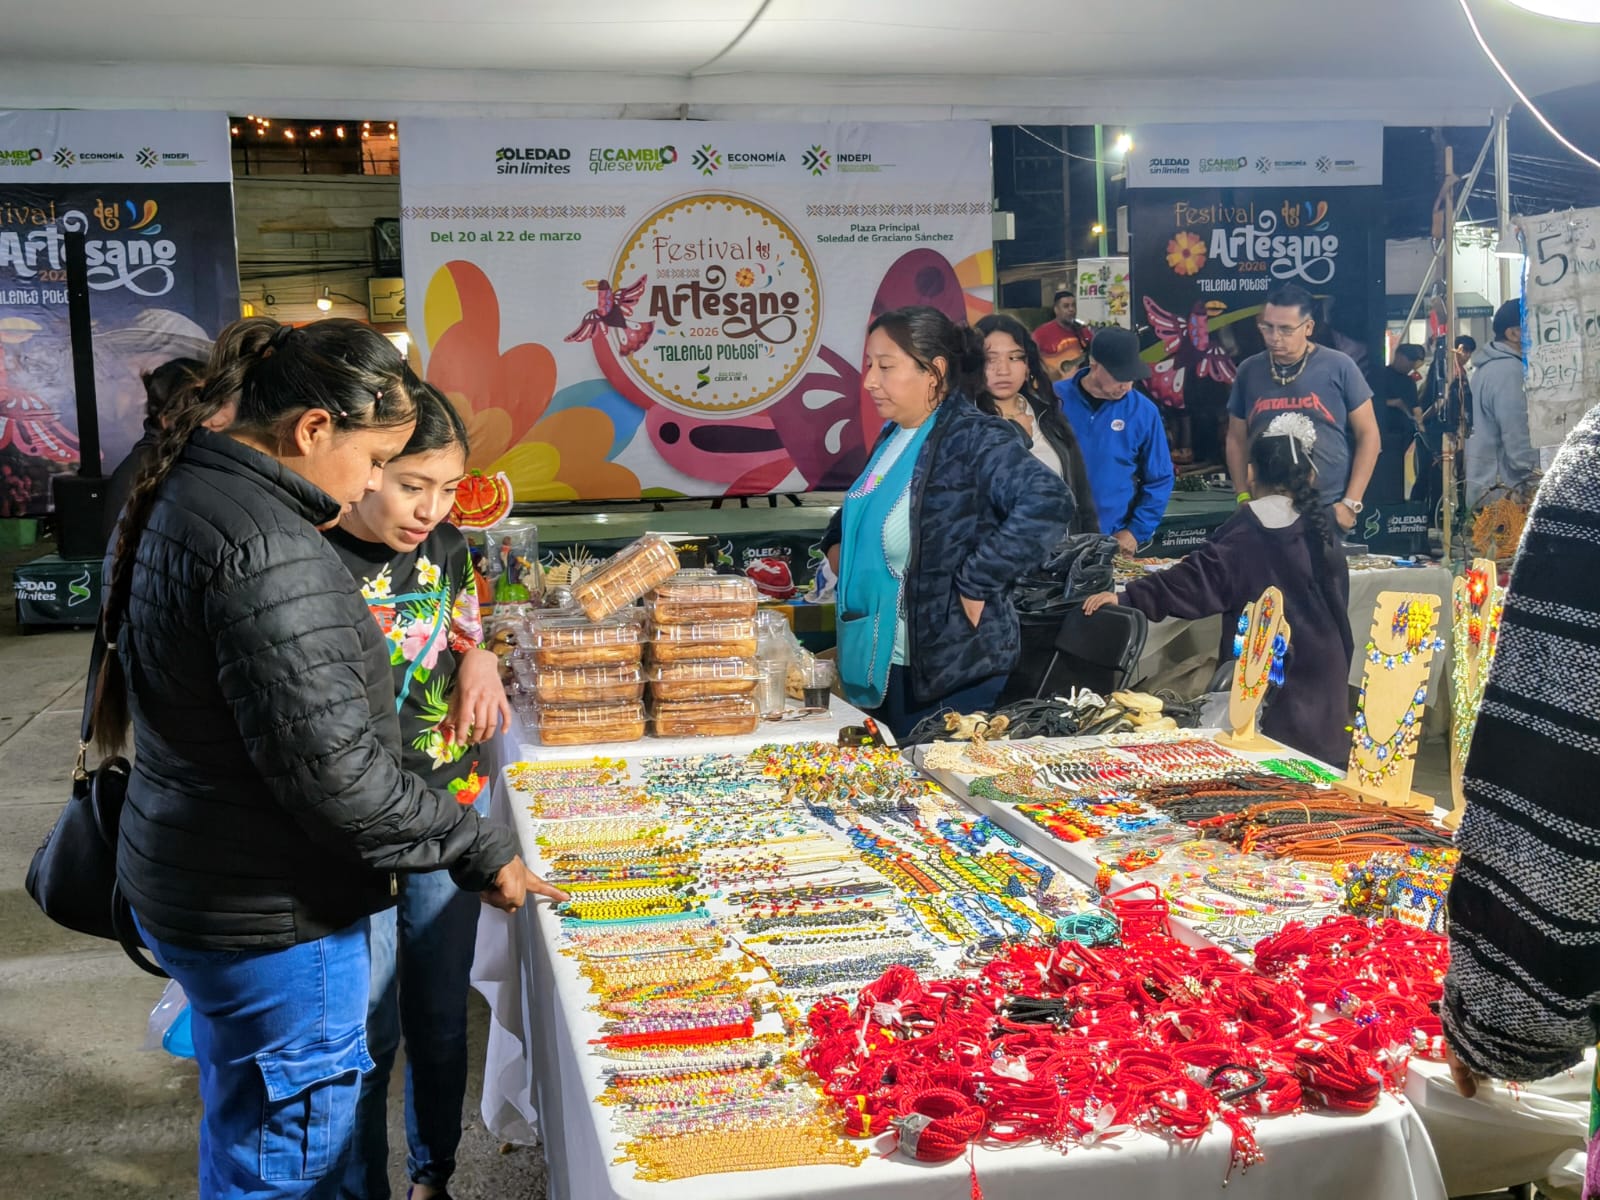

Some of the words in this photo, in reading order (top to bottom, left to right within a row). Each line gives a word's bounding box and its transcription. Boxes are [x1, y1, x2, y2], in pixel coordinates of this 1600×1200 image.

[79, 152, 124, 160] ECONOMÍA
[495, 147, 571, 162] SOLEDAD
[603, 145, 677, 164] CAMBIO
[728, 151, 786, 162] ECONOMÍA
[837, 153, 872, 162] INDEPI
[497, 162, 518, 174] sin
[589, 161, 616, 175] que
[619, 161, 633, 172] se
[635, 161, 664, 172] vive
[93, 199, 120, 231] del
[1174, 201, 1254, 227] Festival
[1281, 200, 1300, 228] del
[850, 223, 877, 232] Plaza
[879, 223, 920, 233] Principal
[430, 231, 454, 243] Del
[457, 231, 477, 242] 20
[480, 230, 494, 242] al
[497, 231, 515, 242] 22
[519, 230, 536, 242] de
[540, 231, 582, 242] marzo
[817, 234, 855, 243] Soledad
[857, 234, 869, 242] de
[871, 234, 912, 243] Graciano
[914, 232, 954, 242] Sánchez
[0, 210, 176, 297] Artsano
[652, 235, 753, 264] Festival
[755, 240, 770, 260] del
[1209, 209, 1339, 284] Artesano
[1535, 233, 1569, 286] 5
[40, 269, 68, 281] 202
[649, 265, 799, 344] Artesano
[690, 327, 719, 337] 2026
[1248, 391, 1336, 424] METALLICA
